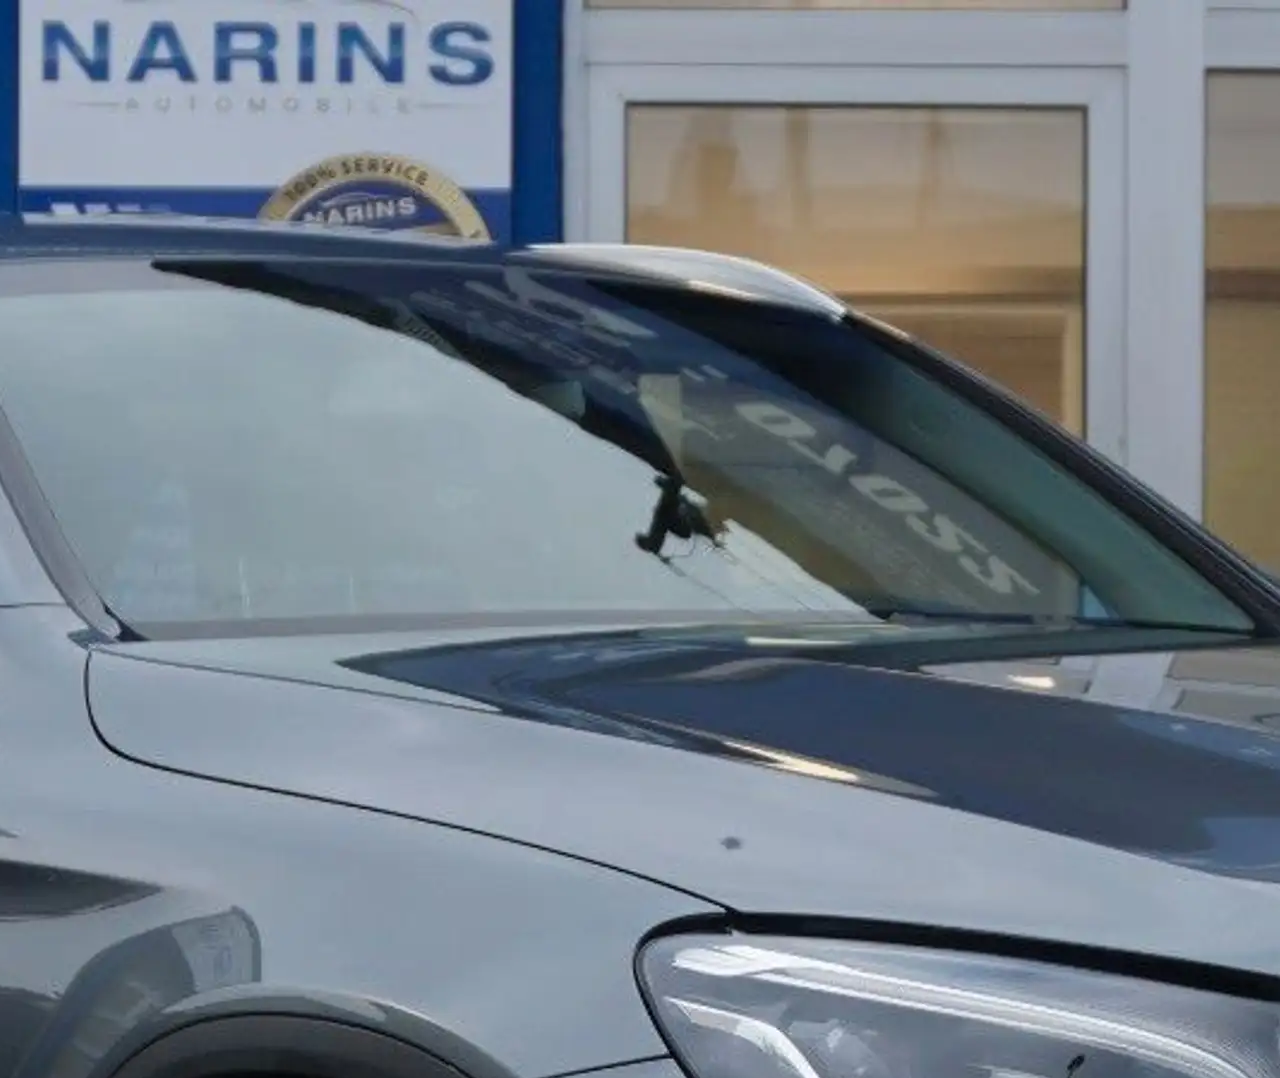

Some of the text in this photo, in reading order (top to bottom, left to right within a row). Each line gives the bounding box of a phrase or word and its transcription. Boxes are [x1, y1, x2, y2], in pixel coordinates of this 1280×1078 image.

[41, 20, 494, 87] NARINS
[125, 96, 412, 114] AUTOMOBILE
[341, 157, 429, 185] SERVICE
